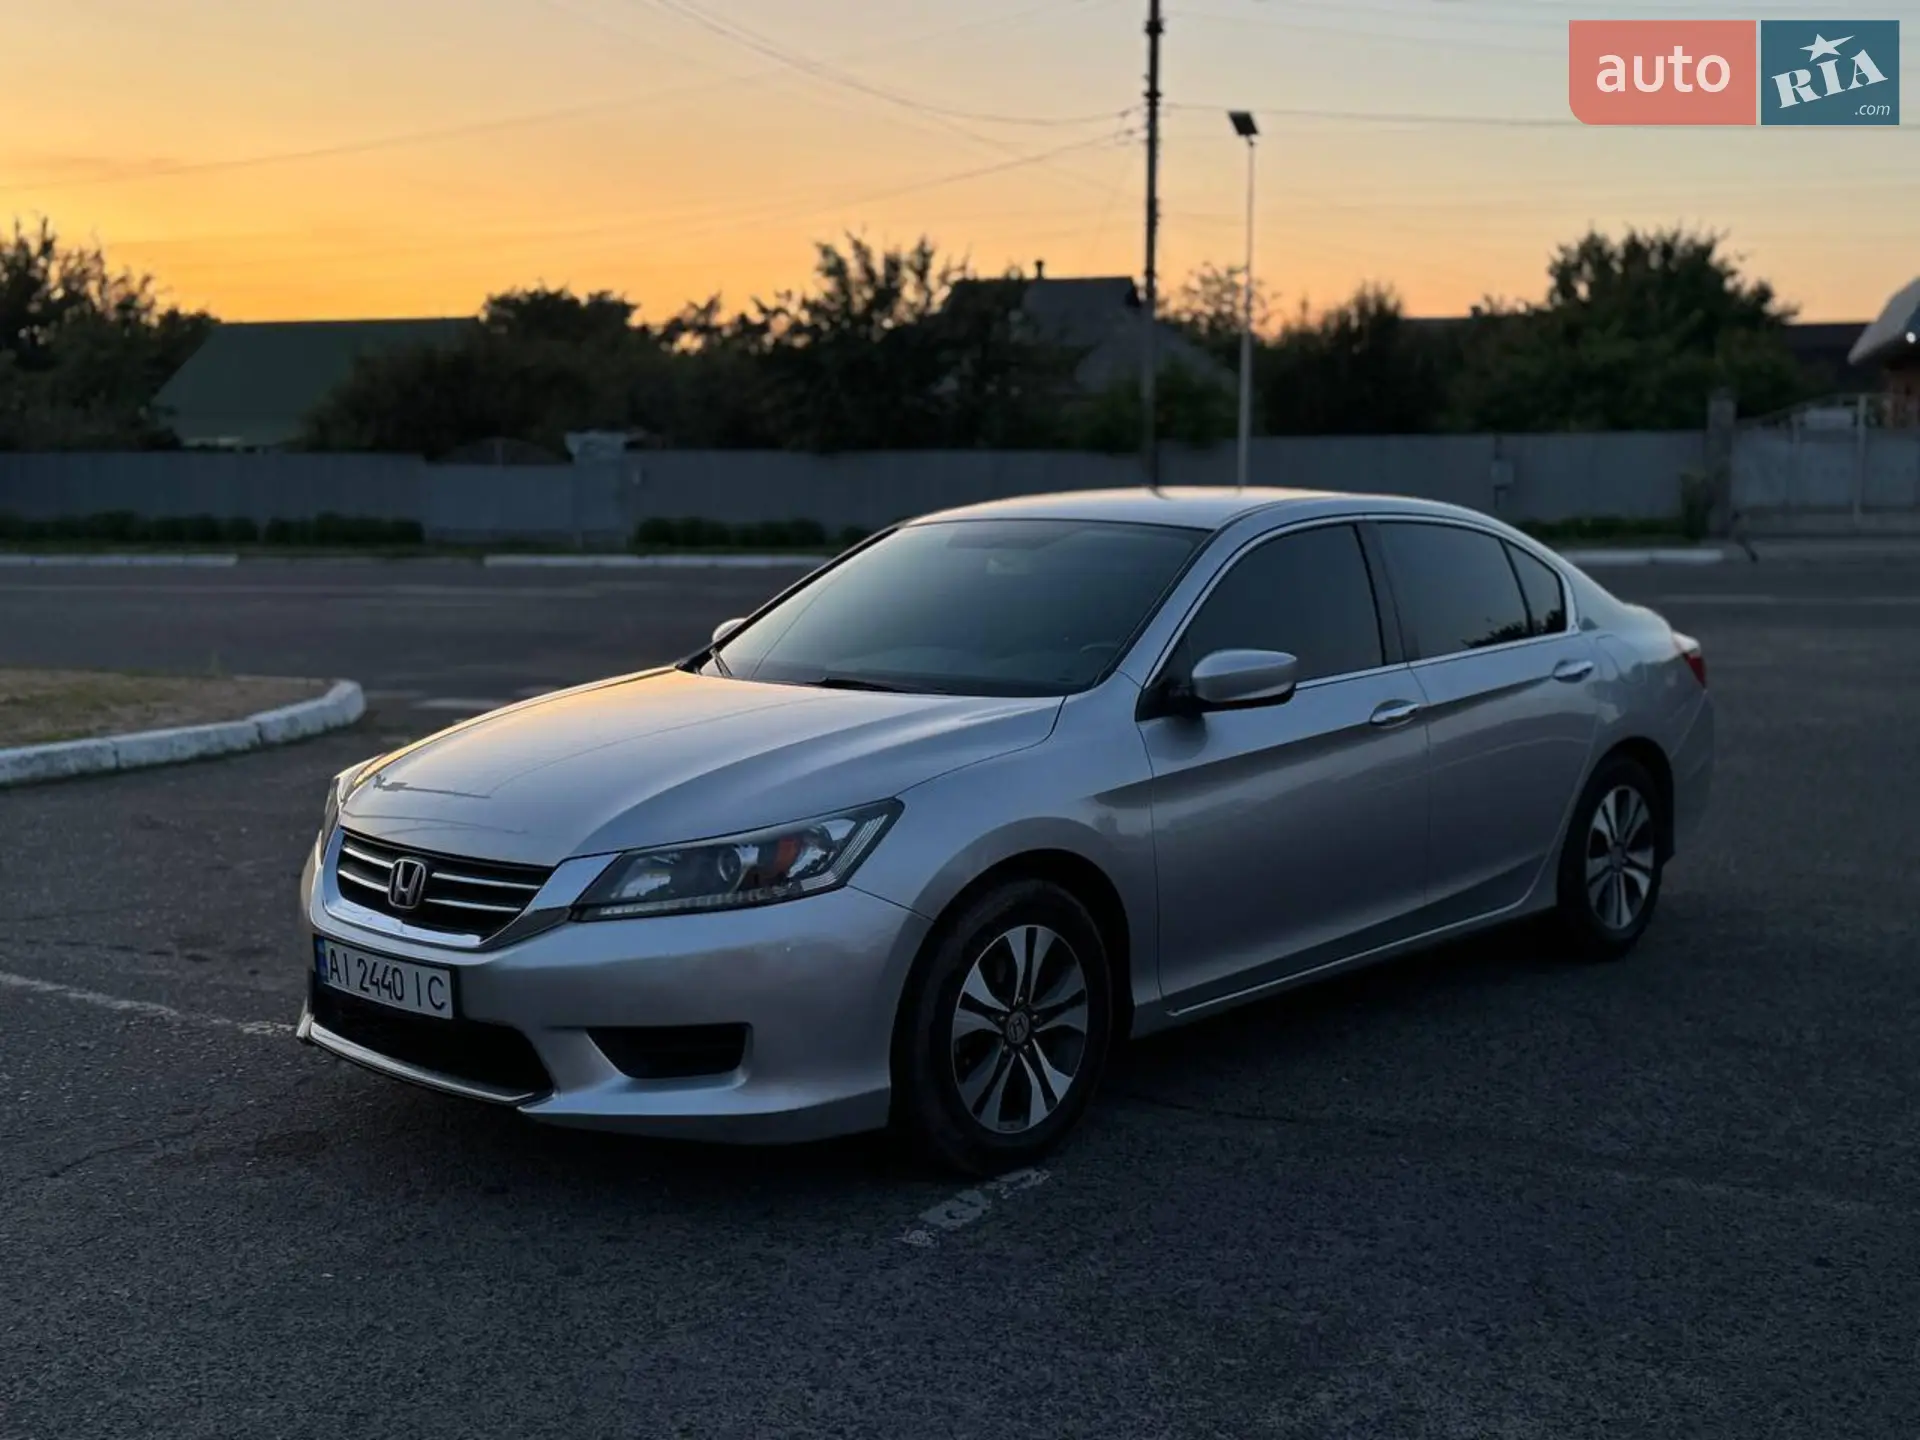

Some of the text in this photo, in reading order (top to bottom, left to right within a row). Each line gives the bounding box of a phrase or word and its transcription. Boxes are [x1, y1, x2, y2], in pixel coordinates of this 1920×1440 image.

[329, 948, 349, 986] AI
[357, 958, 405, 1001] 2440
[415, 972, 446, 1011] IC
